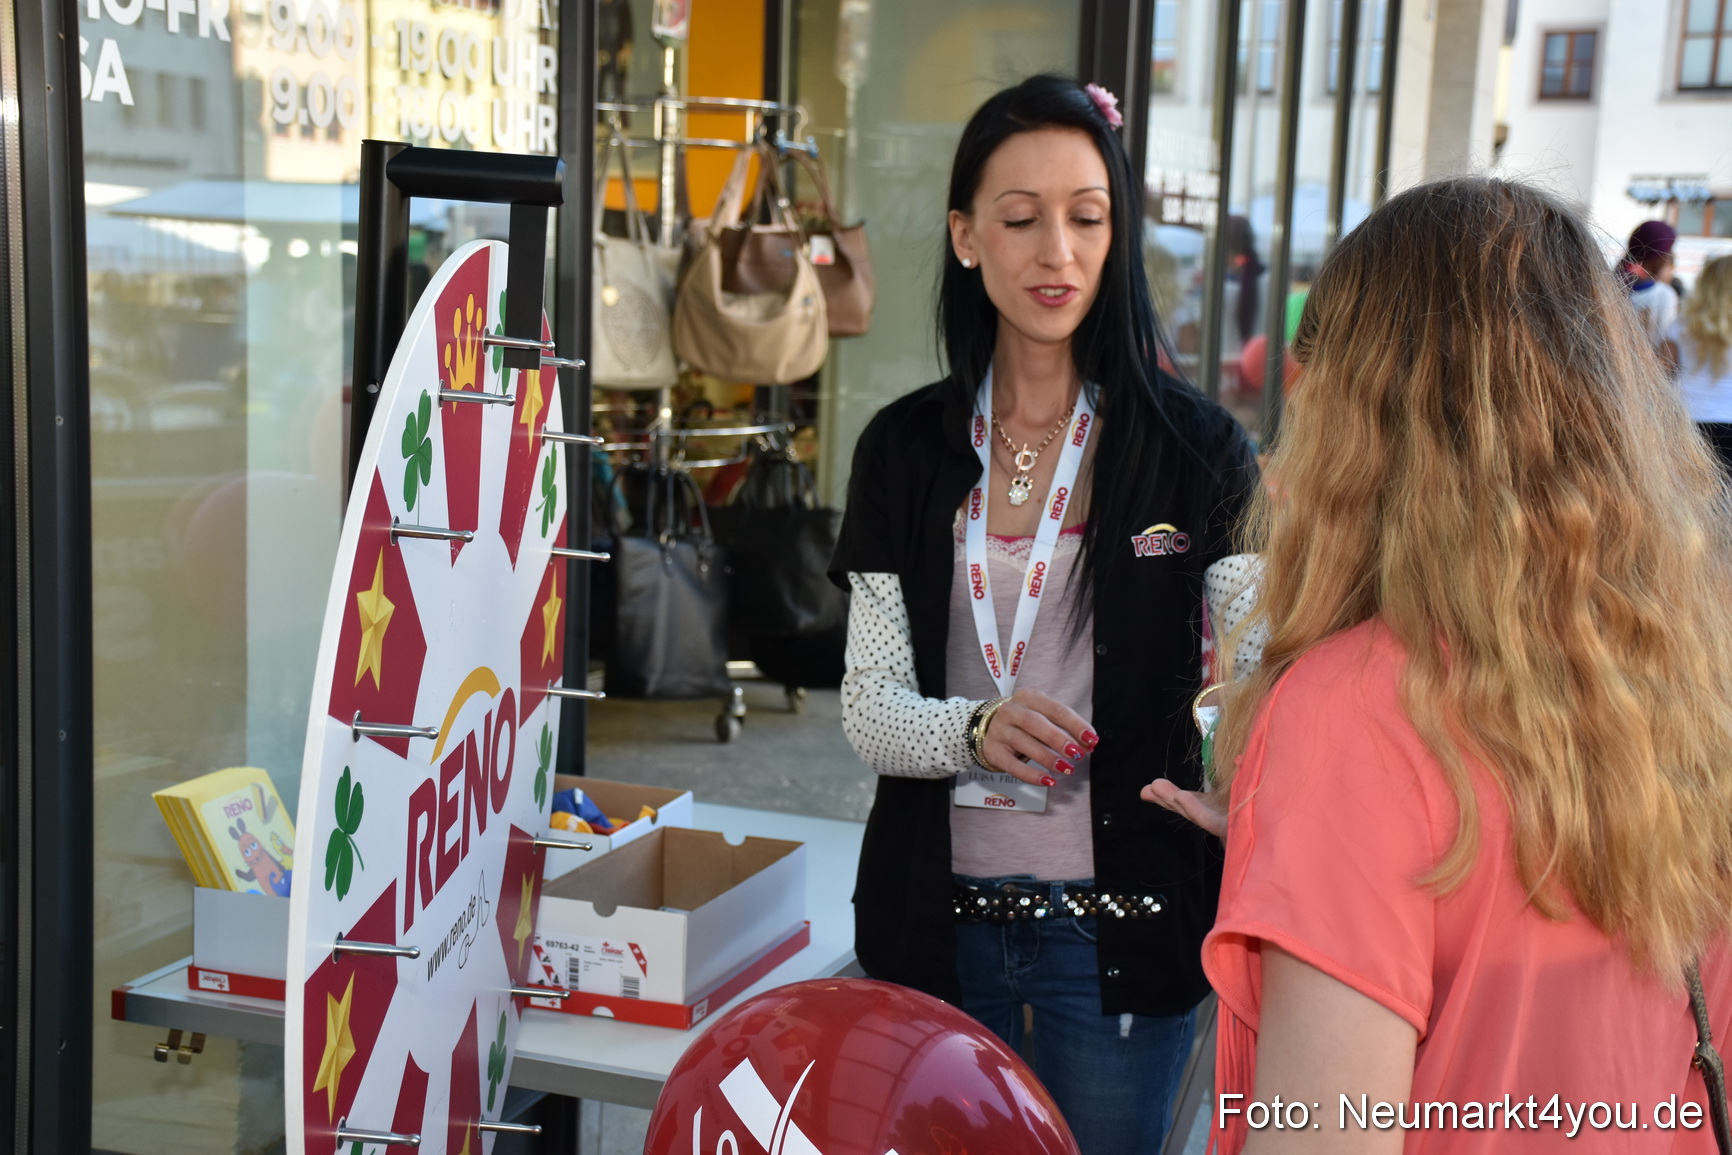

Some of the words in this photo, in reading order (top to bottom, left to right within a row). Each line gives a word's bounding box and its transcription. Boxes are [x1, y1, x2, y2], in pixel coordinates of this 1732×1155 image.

[394, 18, 485, 82] 19.00
[493, 36, 558, 95] UHR
[271, 66, 361, 130] 9.00
[493, 98, 558, 154] UHR
[972, 415, 985, 447] RENO
[1072, 413, 1091, 447] RENO
[969, 487, 982, 521] RENO
[1049, 487, 1069, 521] RENO
[1131, 533, 1191, 558] RENO
[969, 563, 985, 600] RENO
[1028, 561, 1047, 598] RENO
[984, 643, 1002, 679] RENO
[1010, 641, 1026, 676] RENO
[223, 798, 253, 819] RENO
[404, 686, 517, 936] RENO
[984, 796, 1016, 808] RENO
[427, 893, 477, 982] www.reno.de
